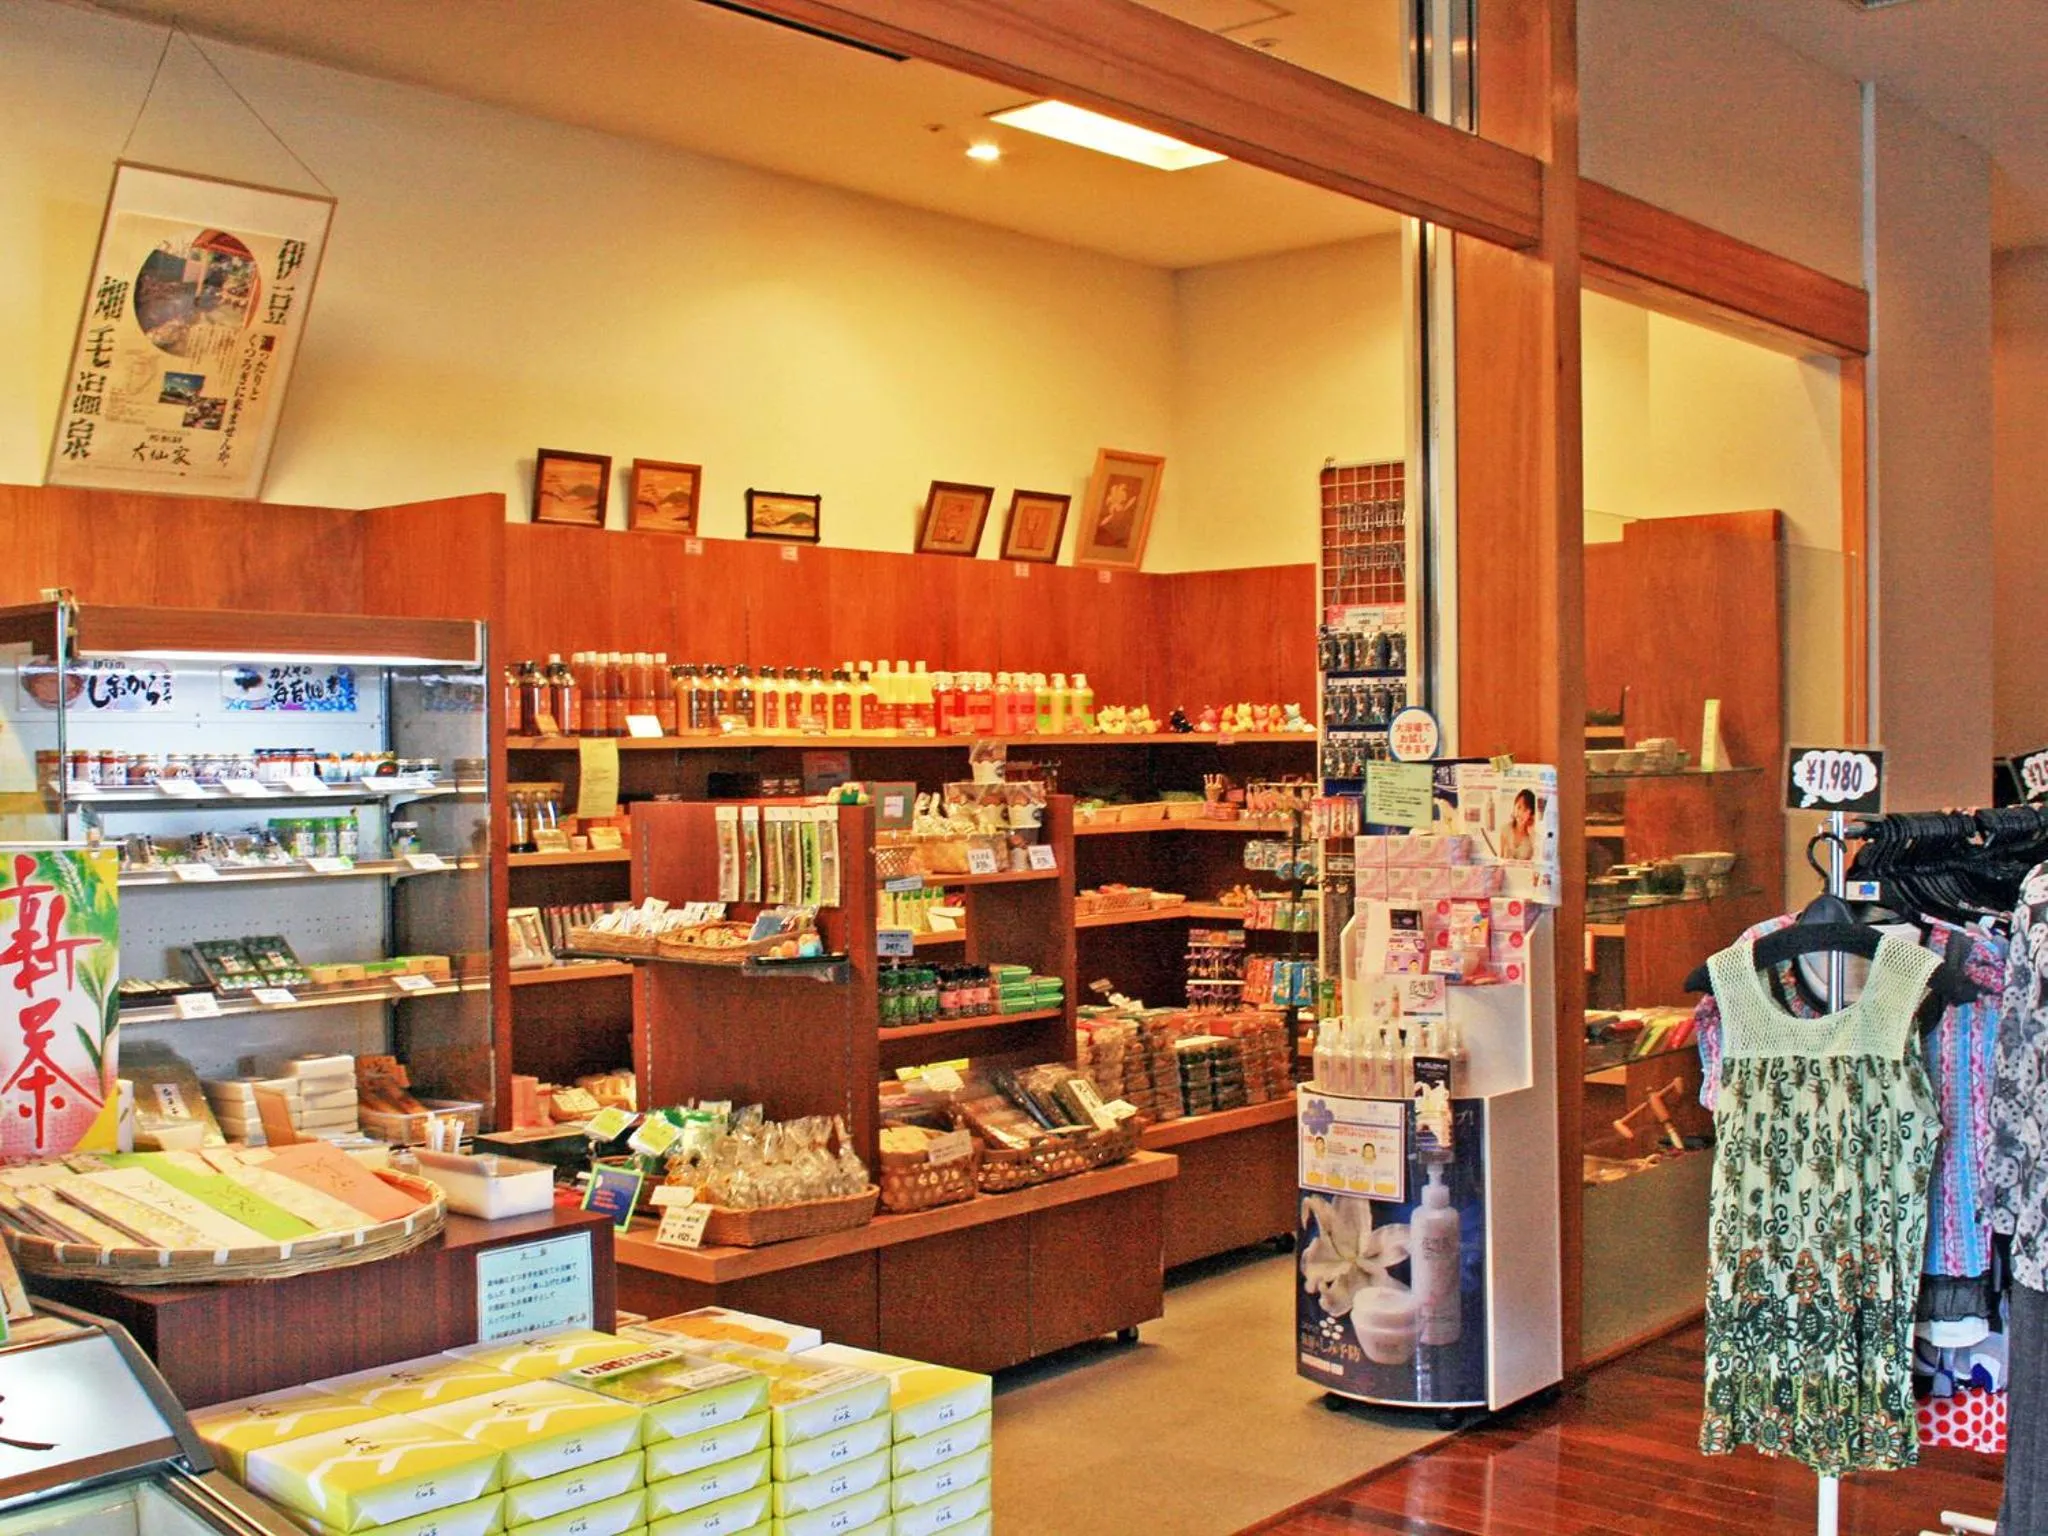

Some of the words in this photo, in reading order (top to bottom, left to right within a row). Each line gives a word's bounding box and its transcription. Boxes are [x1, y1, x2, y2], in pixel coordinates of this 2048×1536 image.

[263, 239, 307, 325] 伊豆
[88, 674, 161, 708] しおから
[0, 853, 105, 1149] 新茶
